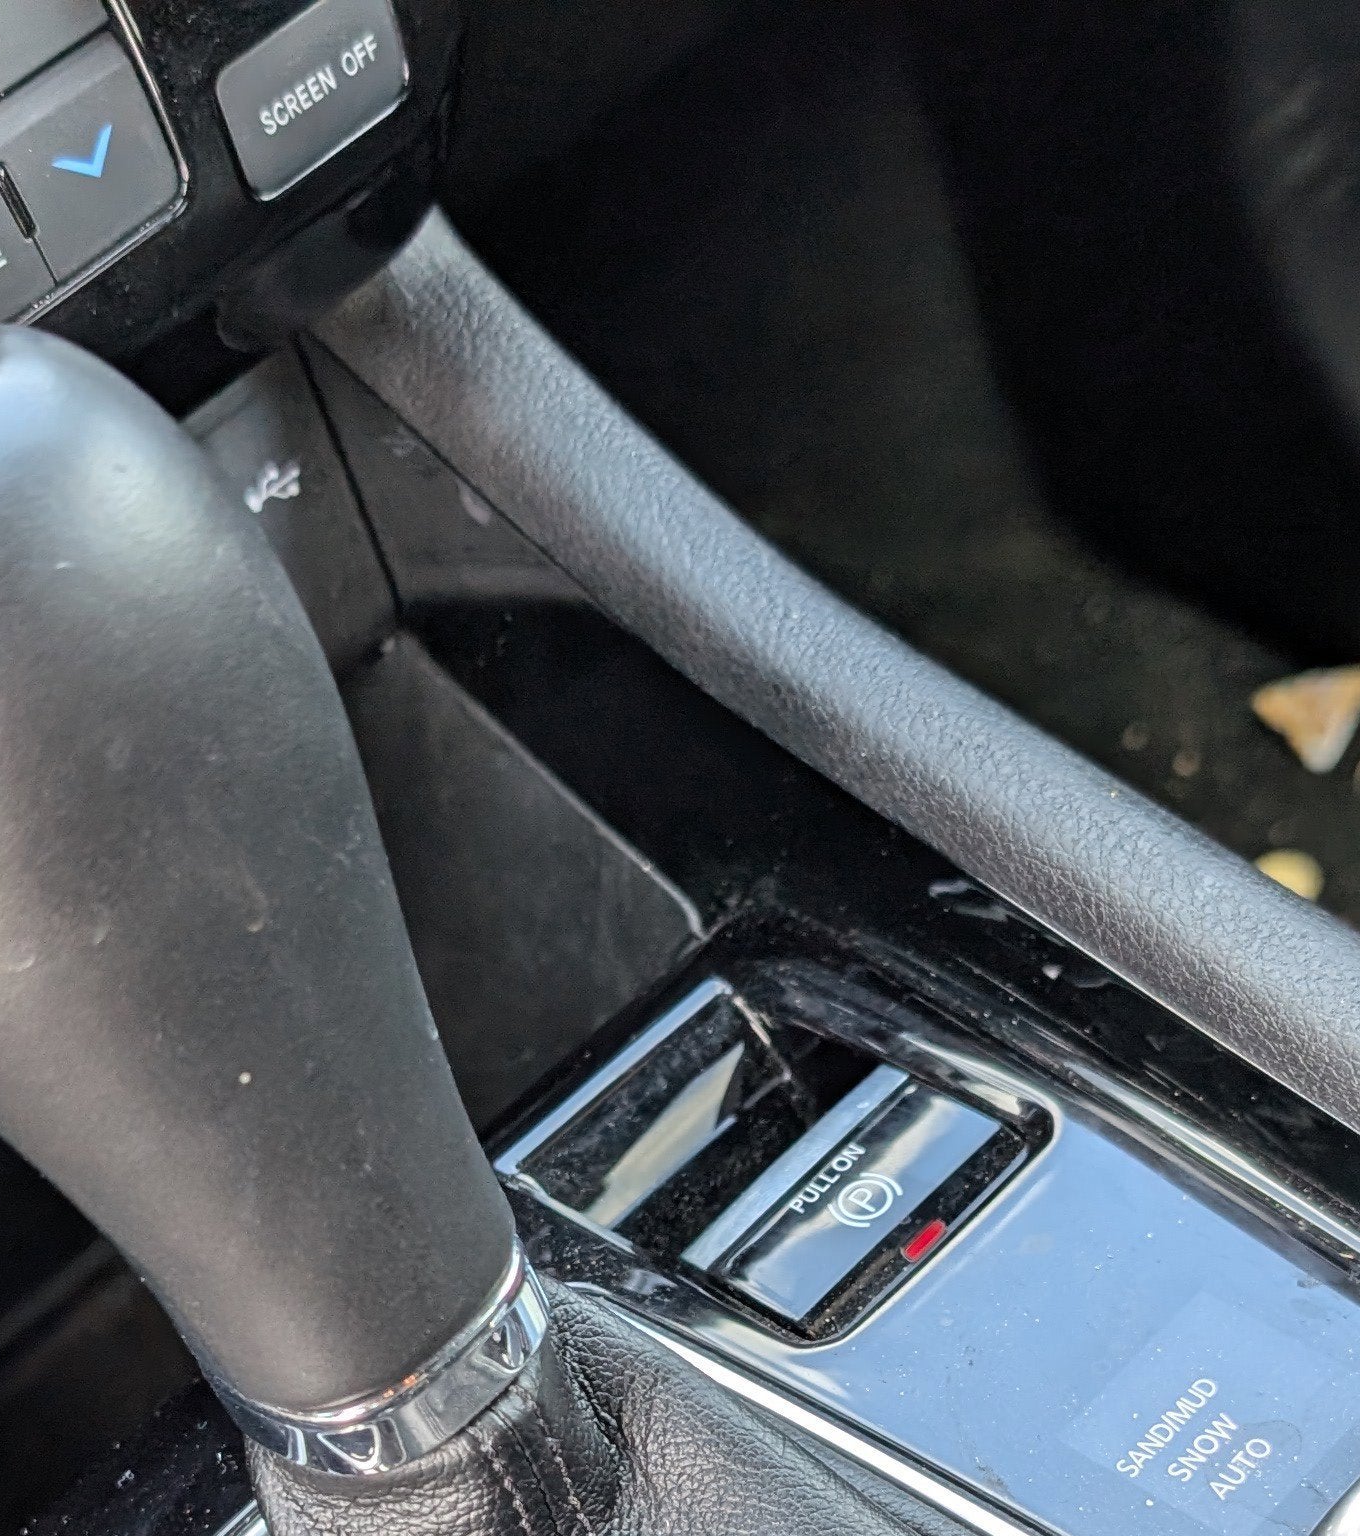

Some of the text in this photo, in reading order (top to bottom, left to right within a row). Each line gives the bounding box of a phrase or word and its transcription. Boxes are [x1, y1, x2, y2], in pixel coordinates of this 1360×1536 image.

[259, 34, 377, 136] SCREEN OFF
[790, 1142, 866, 1214] PULL ON
[1116, 1378, 1217, 1478] SAND/MUD
[1167, 1412, 1238, 1482] SNOW
[1209, 1438, 1272, 1500] AUTO
